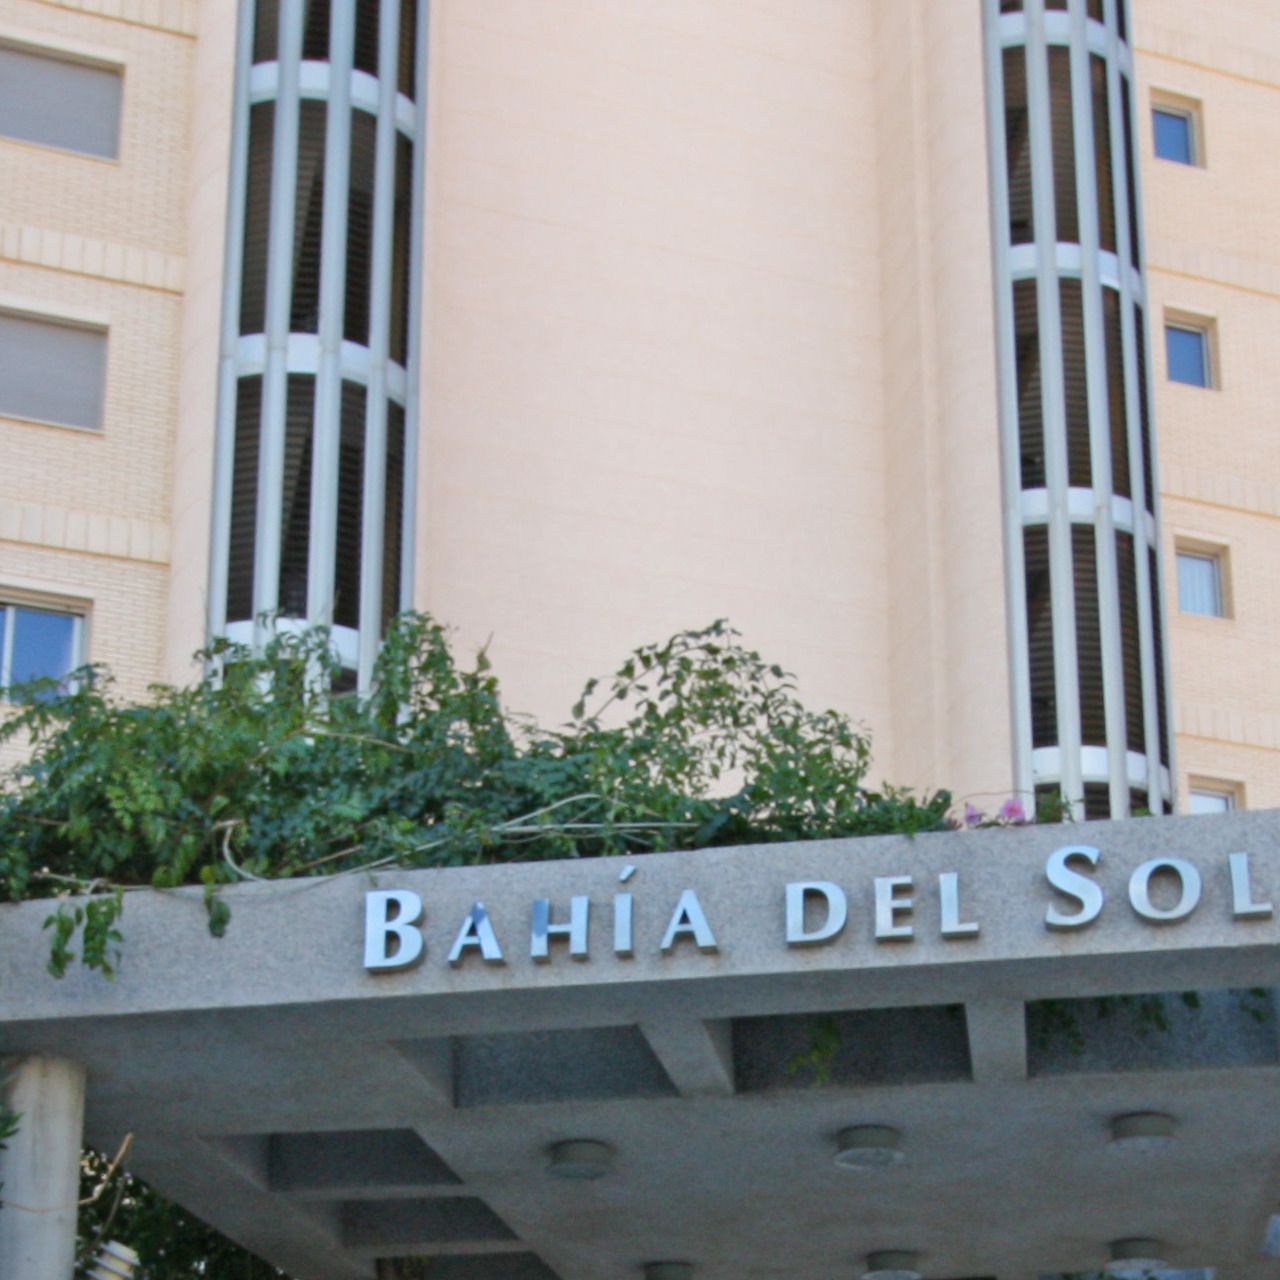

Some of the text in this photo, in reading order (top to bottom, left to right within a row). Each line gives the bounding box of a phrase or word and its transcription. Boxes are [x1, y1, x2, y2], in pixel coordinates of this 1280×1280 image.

[363, 844, 1275, 974] BAHÍA DEL SOL
